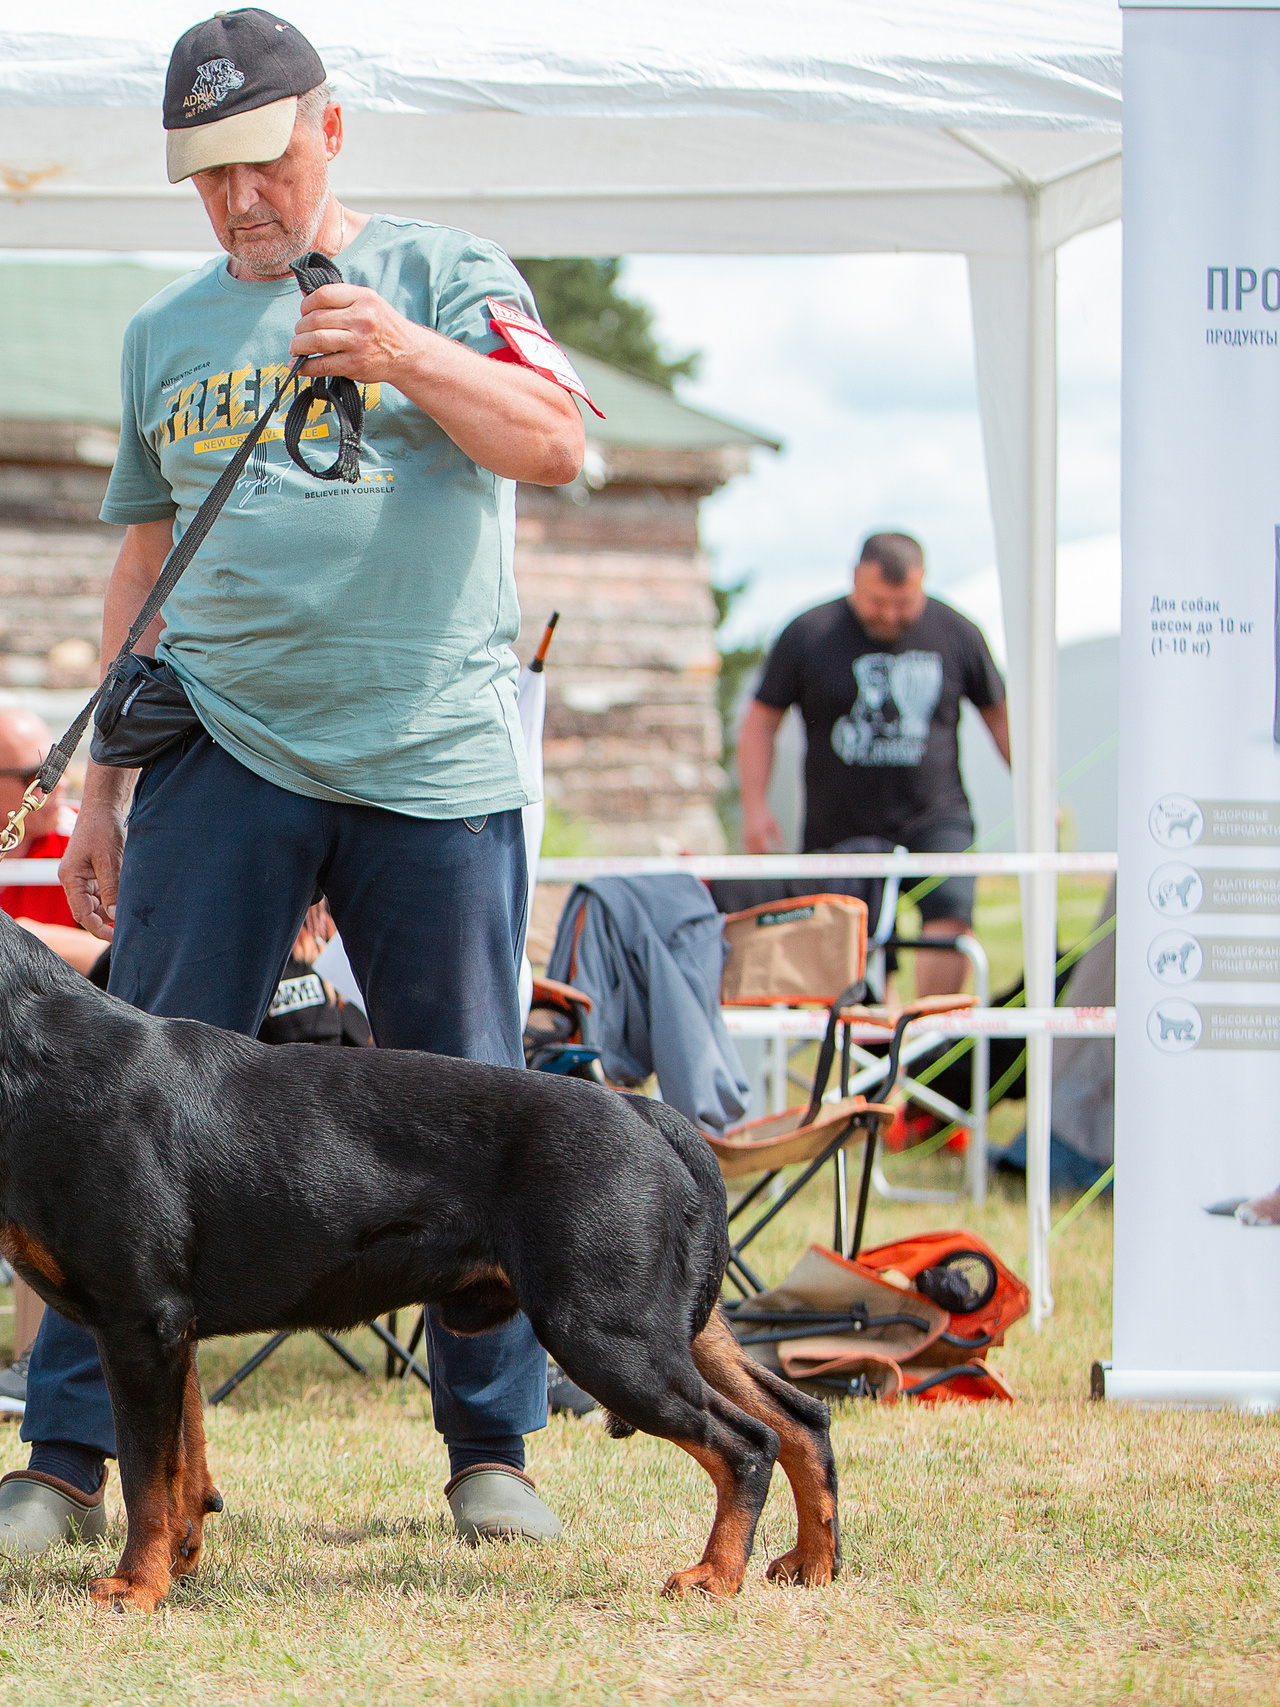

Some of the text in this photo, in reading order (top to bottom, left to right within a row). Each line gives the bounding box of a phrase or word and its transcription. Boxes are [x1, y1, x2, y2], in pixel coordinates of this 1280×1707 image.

[182, 90, 217, 108] ADRK
[1206, 328, 1278, 347] ПРОДУКТЫ
[203, 438, 227, 451] NEW
[304, 486, 395, 499] BELIEVE IN YOURSELF
[1151, 595, 1220, 612] Для собак
[1151, 617, 1254, 634] весом до 10 кг
[272, 980, 320, 1009] ARVEL
